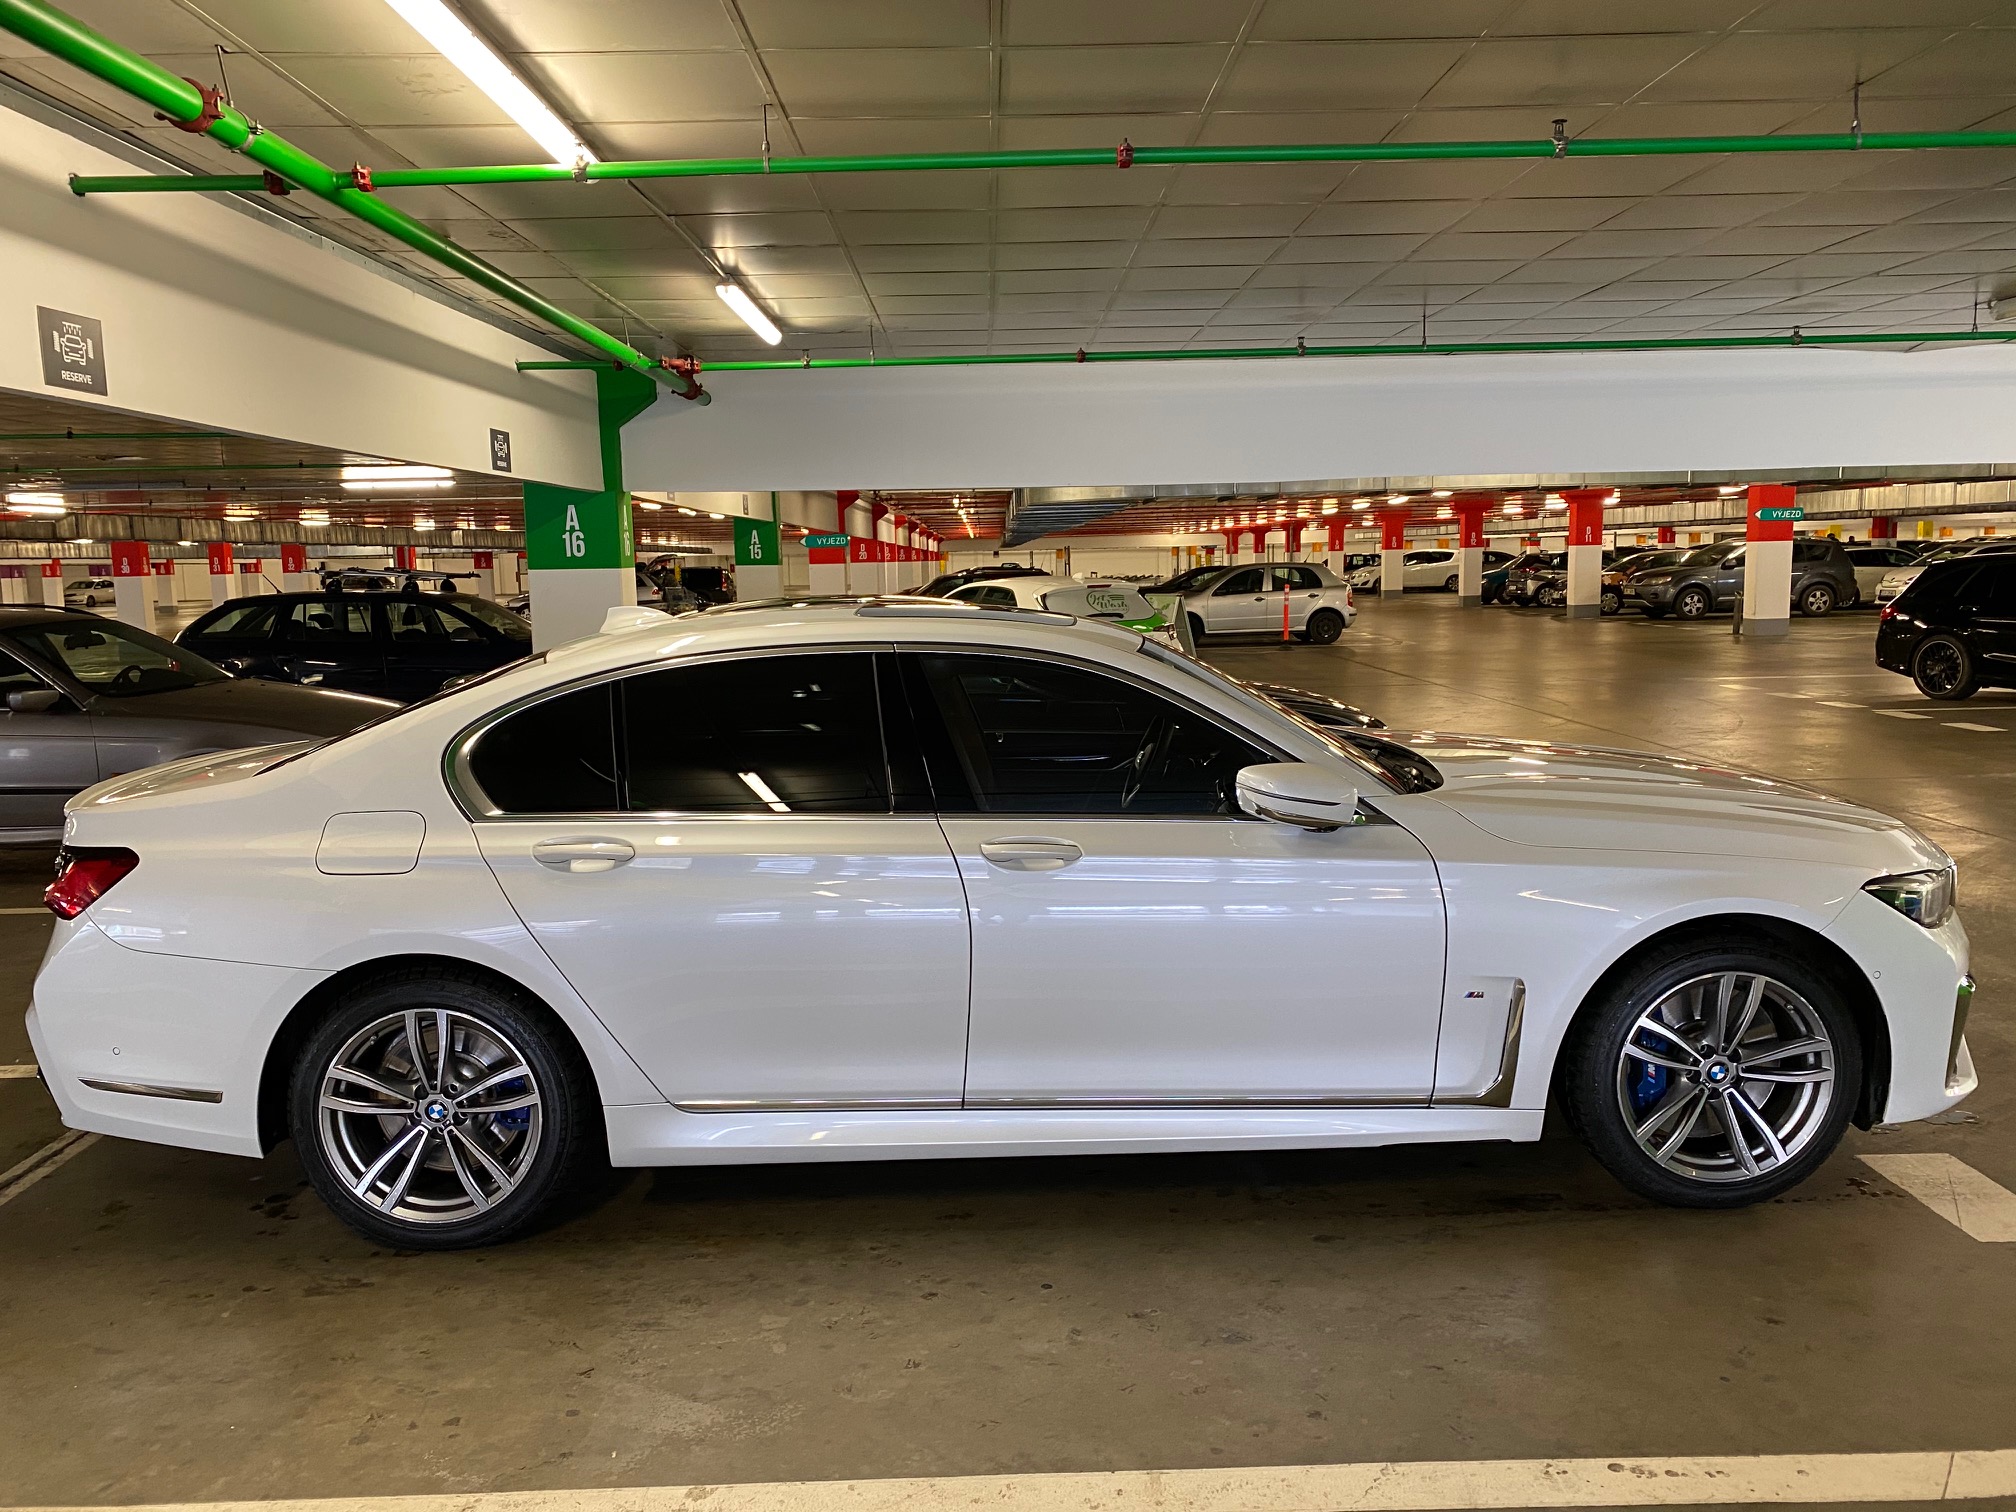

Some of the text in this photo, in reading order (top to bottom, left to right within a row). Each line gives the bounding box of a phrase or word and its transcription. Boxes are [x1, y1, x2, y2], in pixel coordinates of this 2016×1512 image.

[61, 370, 92, 384] RESERVE
[565, 505, 580, 530] A
[1772, 509, 1801, 518] VÝJEZD
[751, 530, 759, 544] A
[816, 536, 846, 545] VÝJEZD
[562, 531, 585, 557] 16
[860, 544, 866, 552] D
[749, 545, 762, 559] 15
[859, 552, 867, 560] 20
[122, 558, 128, 566] D
[121, 565, 130, 573] 30
